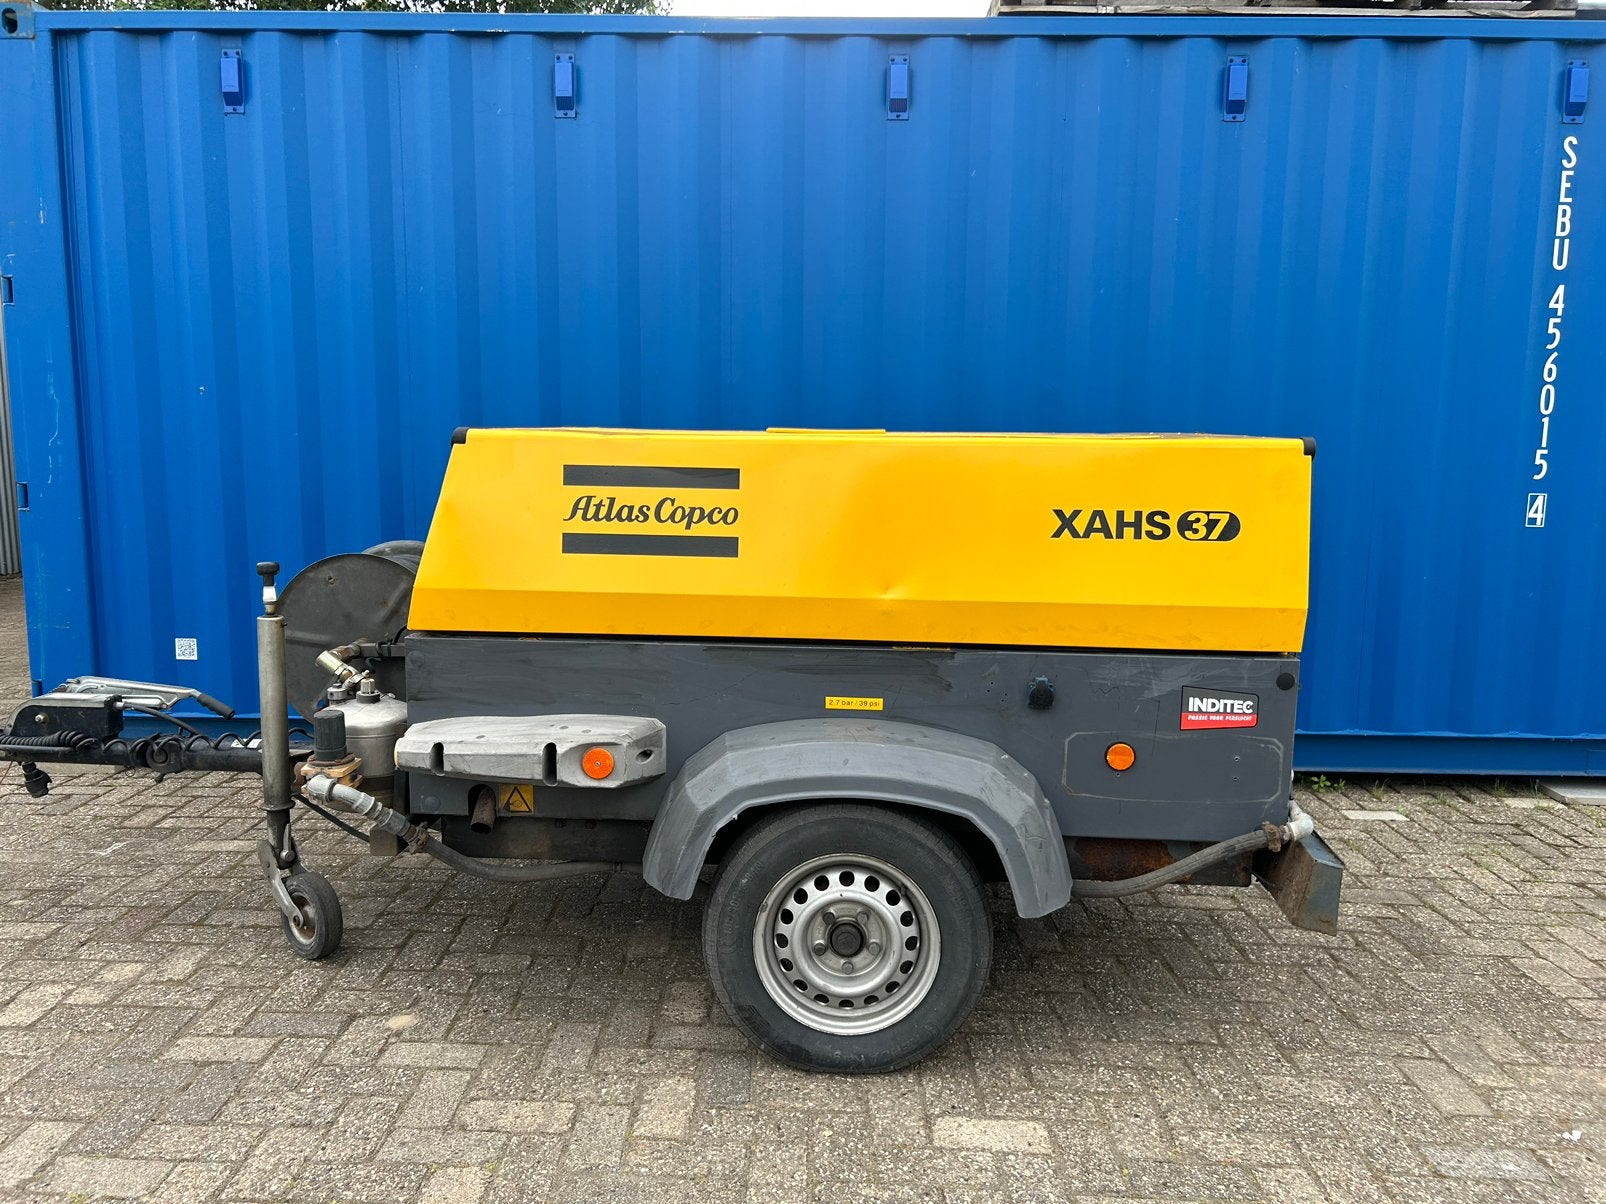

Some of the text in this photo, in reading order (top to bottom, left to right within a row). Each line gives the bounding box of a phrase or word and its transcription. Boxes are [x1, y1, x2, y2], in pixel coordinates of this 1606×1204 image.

[1528, 136, 1578, 526] SEBU 456015 4
[563, 495, 739, 530] Atlas Copco
[1050, 509, 1230, 541] XAHS 37
[869, 700, 880, 708] psi
[1188, 697, 1254, 714] INDITEC
